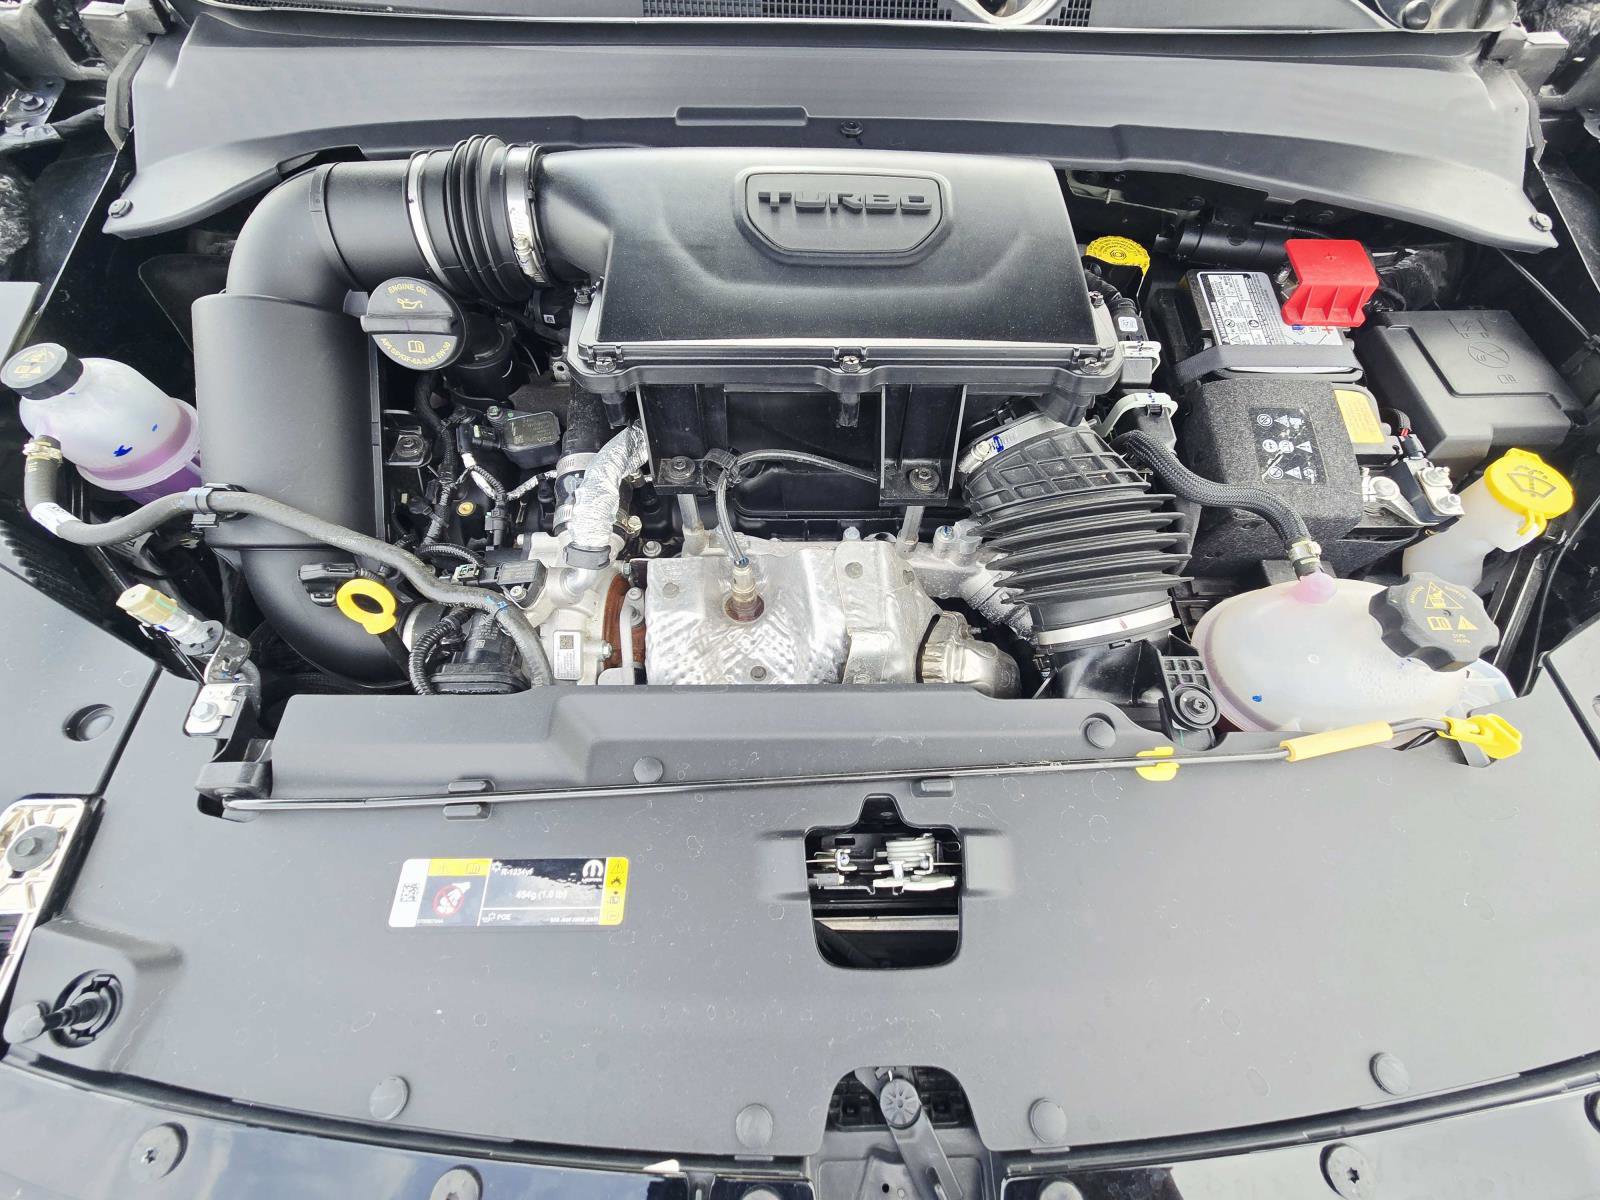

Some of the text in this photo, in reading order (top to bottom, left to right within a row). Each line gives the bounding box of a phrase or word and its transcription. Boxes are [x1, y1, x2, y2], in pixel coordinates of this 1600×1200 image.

[758, 191, 933, 214] TURBO
[388, 283, 429, 298] ENGINE OIL
